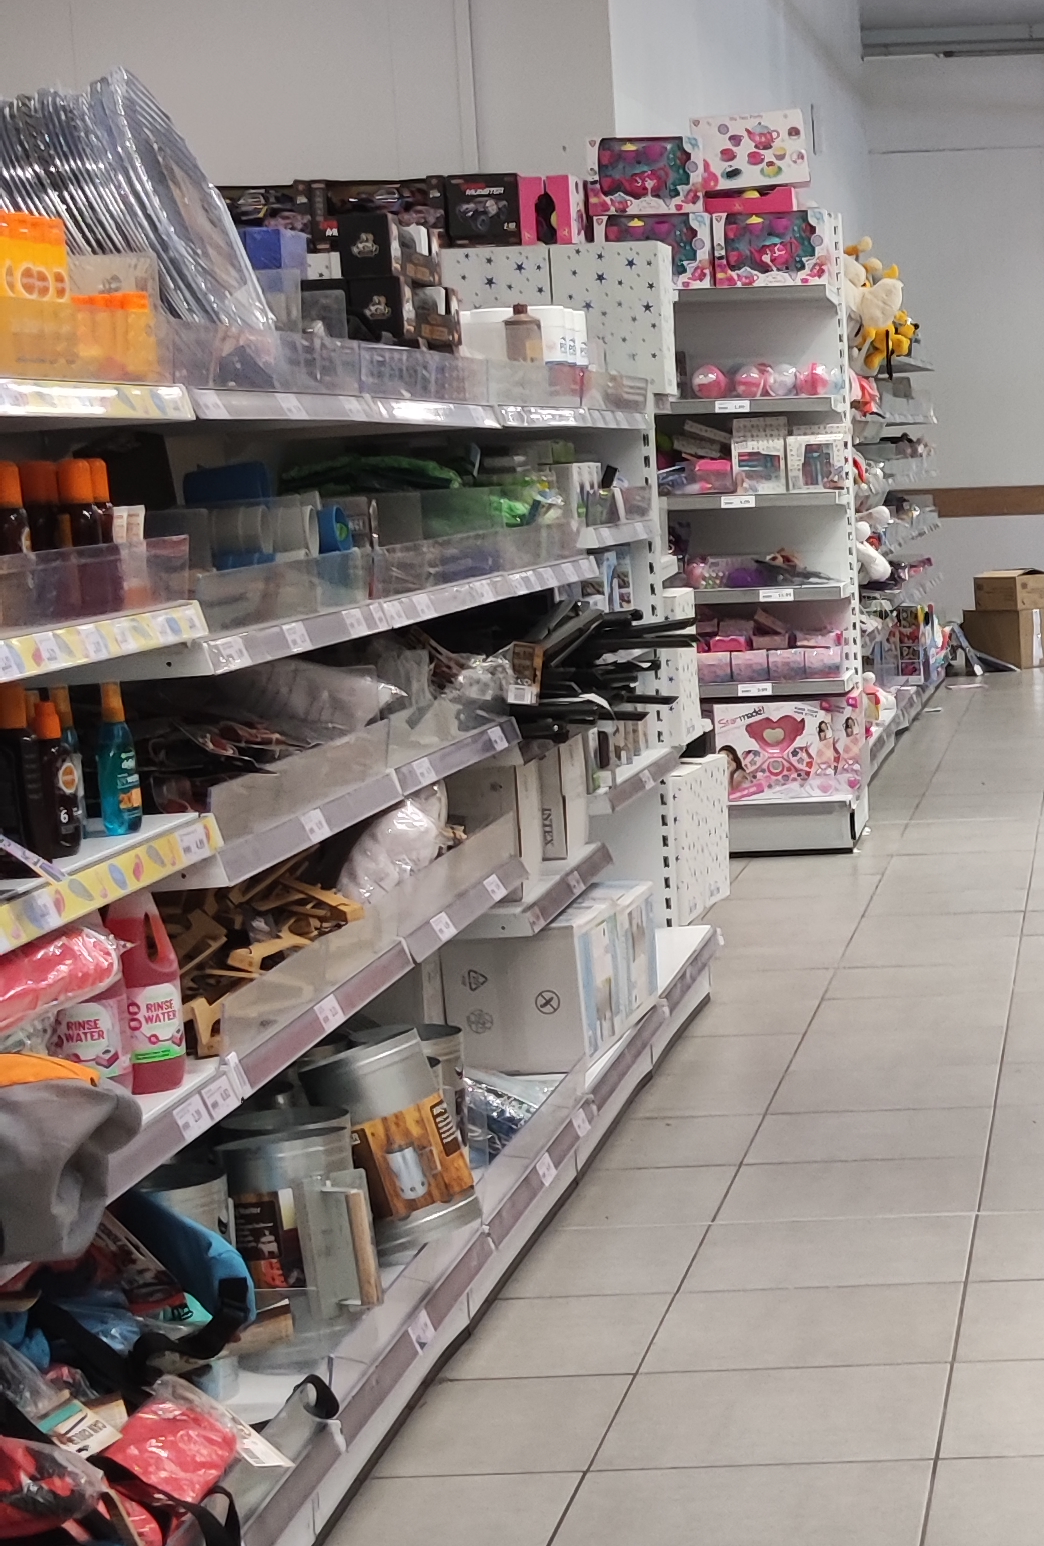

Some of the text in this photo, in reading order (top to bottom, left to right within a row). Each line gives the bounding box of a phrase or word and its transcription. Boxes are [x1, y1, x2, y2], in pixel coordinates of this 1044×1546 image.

[60, 809, 69, 823] 6
[541, 807, 554, 847] INTEX
[145, 998, 176, 1014] RINSE
[66, 1018, 101, 1032] RINSE
[143, 1009, 177, 1026] WATER
[64, 1029, 106, 1044] WATER
